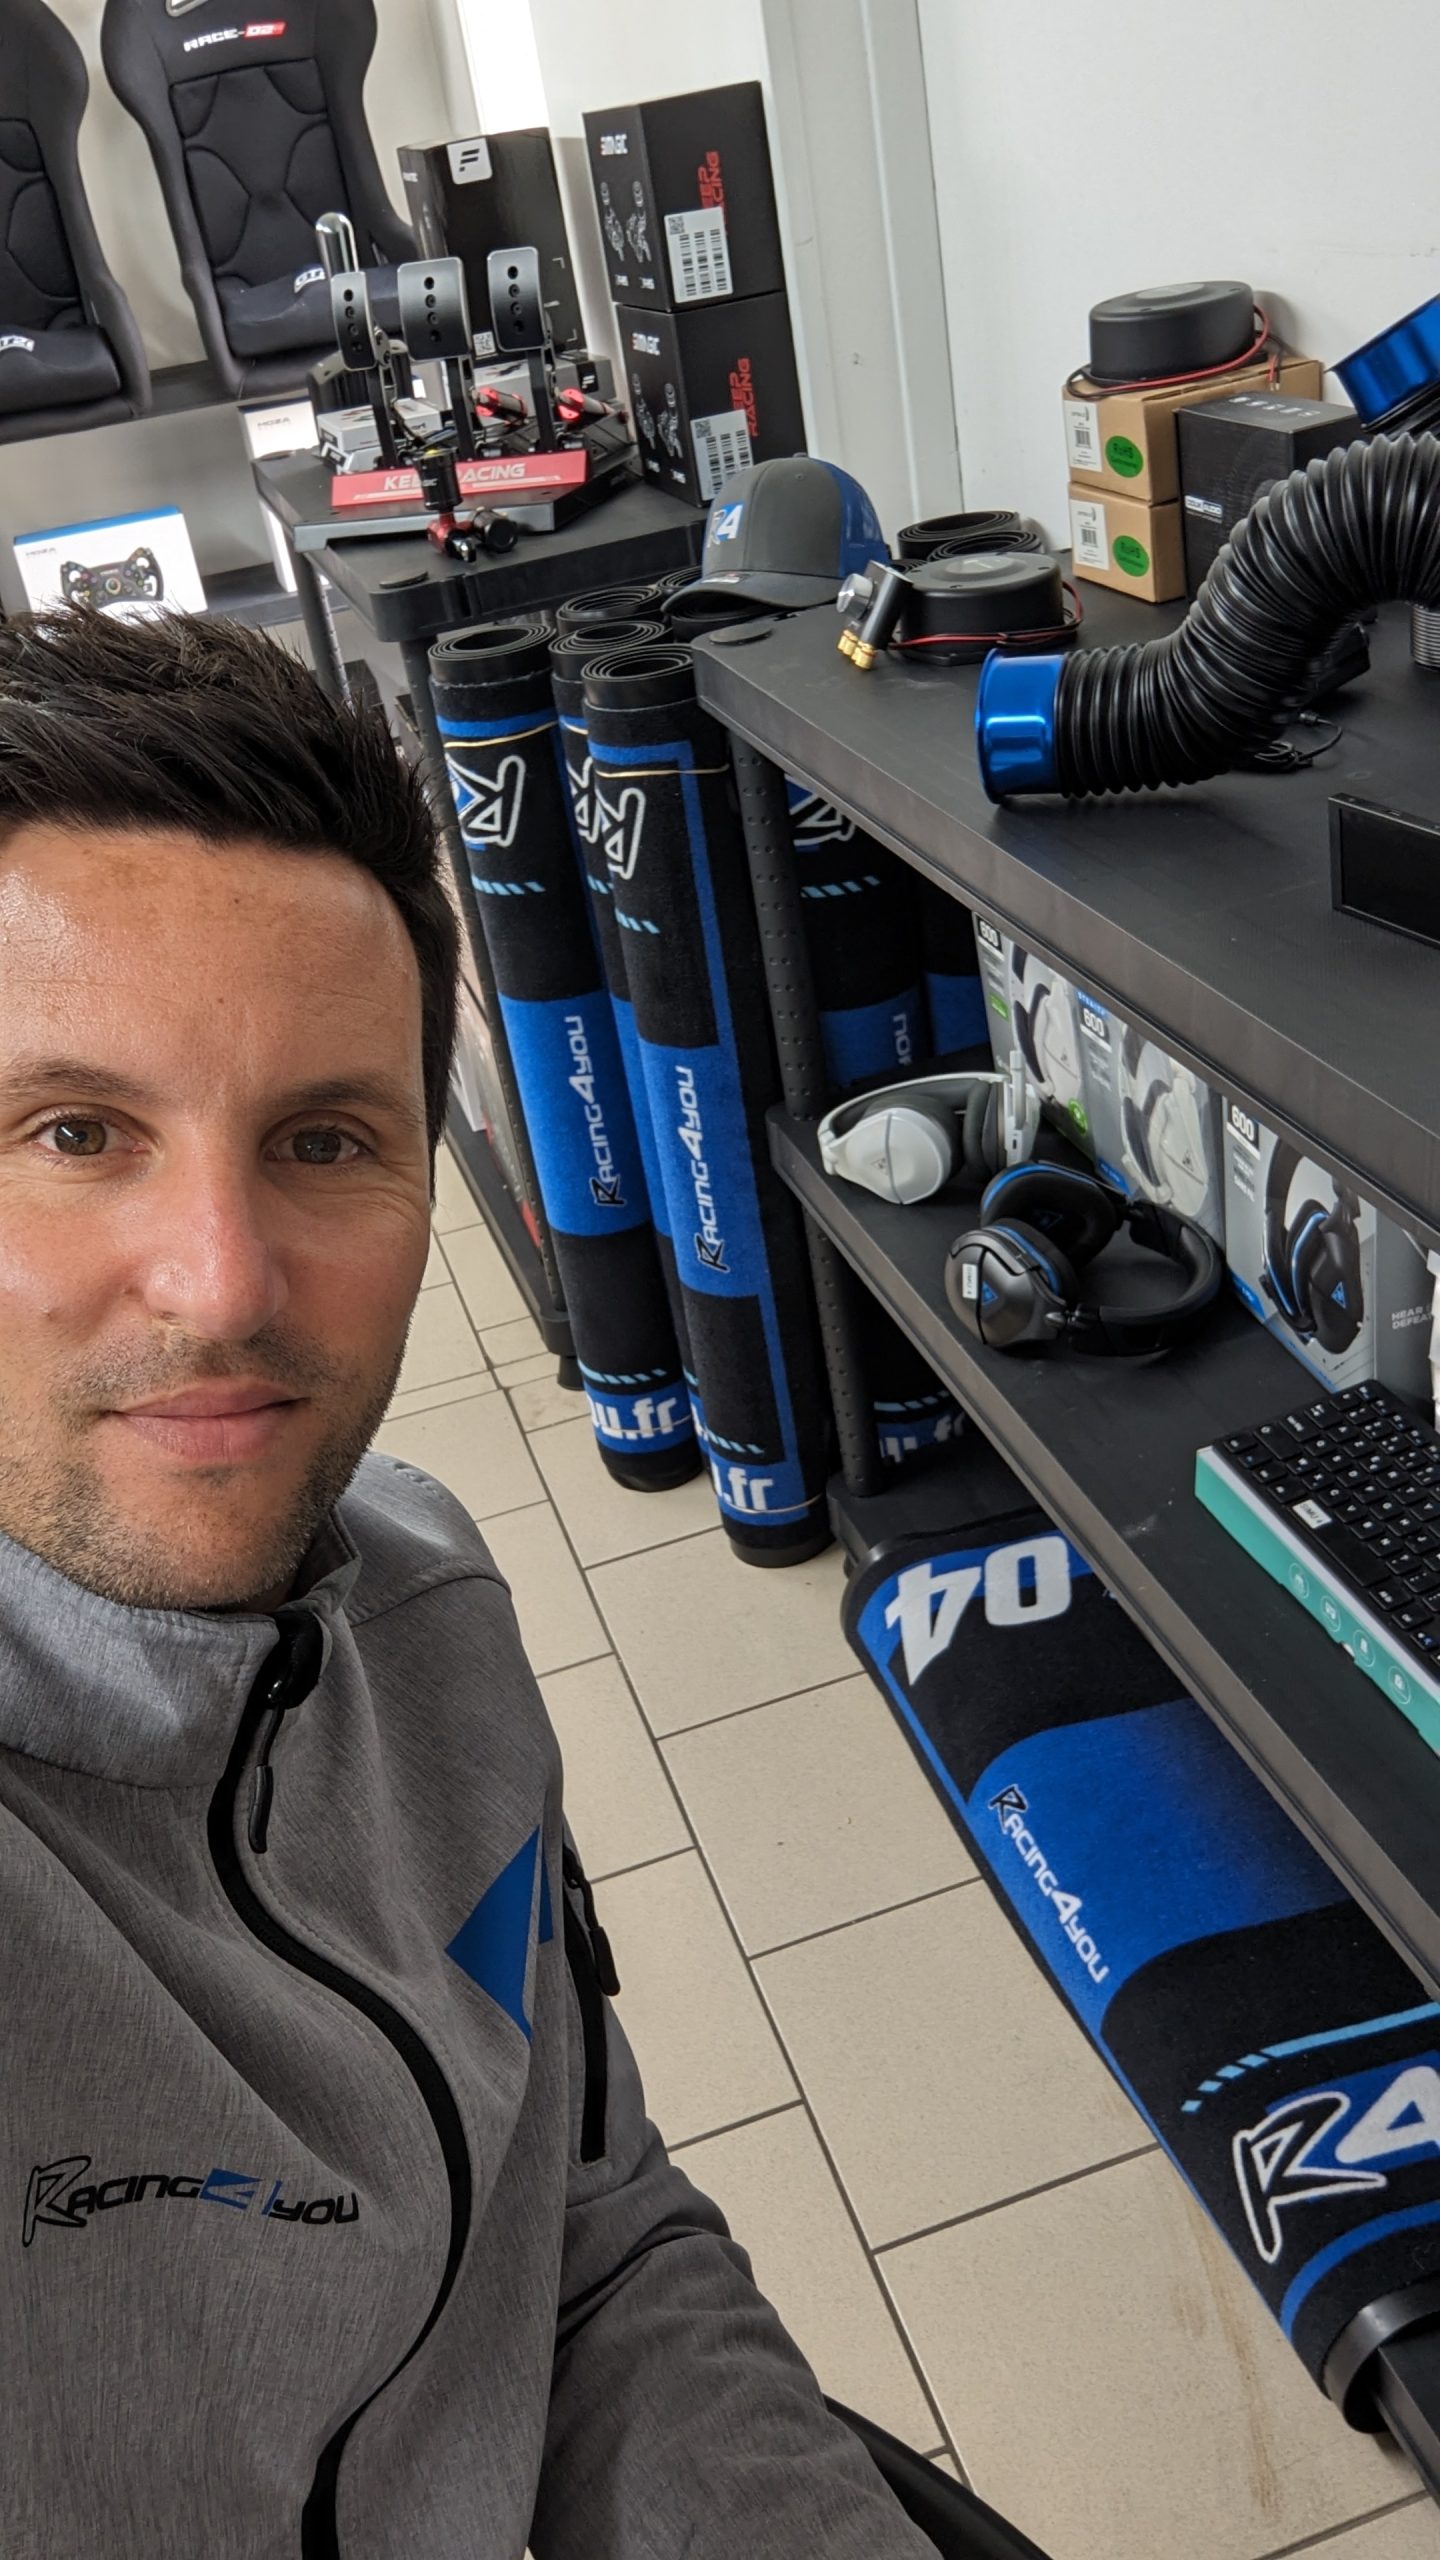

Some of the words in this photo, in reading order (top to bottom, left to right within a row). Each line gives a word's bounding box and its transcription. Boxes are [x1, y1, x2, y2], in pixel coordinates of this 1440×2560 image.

[460, 463, 527, 483] ACING
[1083, 1008, 1105, 1037] 600
[1231, 1105, 1255, 1142] 600
[1391, 1306, 1423, 1321] HEAR
